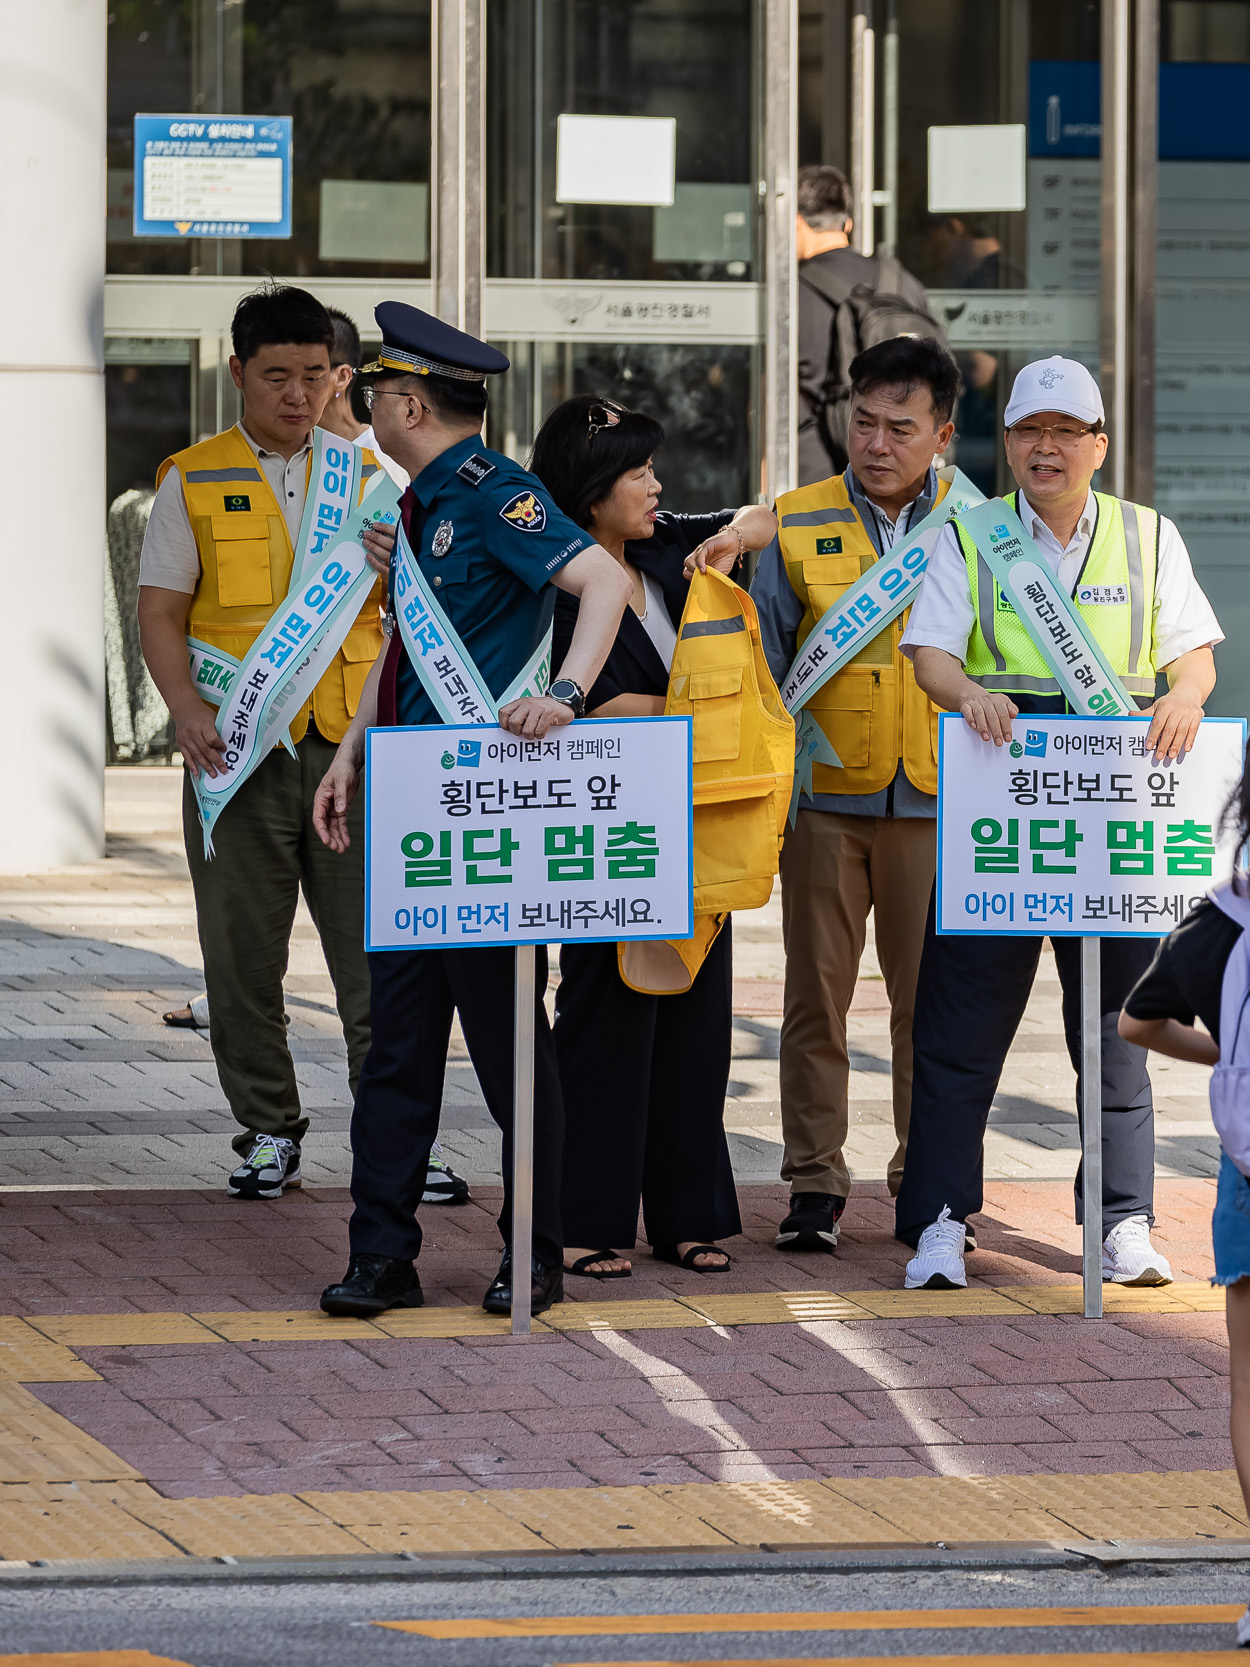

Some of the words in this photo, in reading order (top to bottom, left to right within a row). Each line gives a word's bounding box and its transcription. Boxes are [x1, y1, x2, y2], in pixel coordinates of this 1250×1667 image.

[168, 122, 206, 138] CCTV
[323, 447, 350, 498] 아이
[527, 514, 543, 528] POLICE
[304, 561, 352, 616] 아이
[260, 611, 313, 669] 먼저
[824, 592, 882, 650] 먼저
[1023, 580, 1084, 666] 횡단보도
[1073, 664, 1097, 690] 앞
[404, 595, 445, 657] 먼저
[433, 655, 487, 724] 보내주
[784, 643, 829, 709] 보내주
[487, 739, 561, 764] 아이먼저
[566, 737, 622, 761] 캠페인
[1053, 734, 1123, 756] 아이먼저
[440, 778, 577, 818] 횡단보도
[586, 774, 622, 811] 앞
[1008, 768, 1138, 806] 횡단보도
[1147, 772, 1180, 808] 앞
[400, 827, 520, 888] 일단
[543, 821, 660, 882] 멈춤
[970, 817, 1084, 874] 일단
[1106, 819, 1216, 876] 멈춤
[394, 904, 448, 936] 아이
[457, 902, 510, 935] 먼저
[517, 897, 663, 930] 보내주세요.
[964, 892, 1015, 922] 아이
[1023, 892, 1074, 923] 먼저
